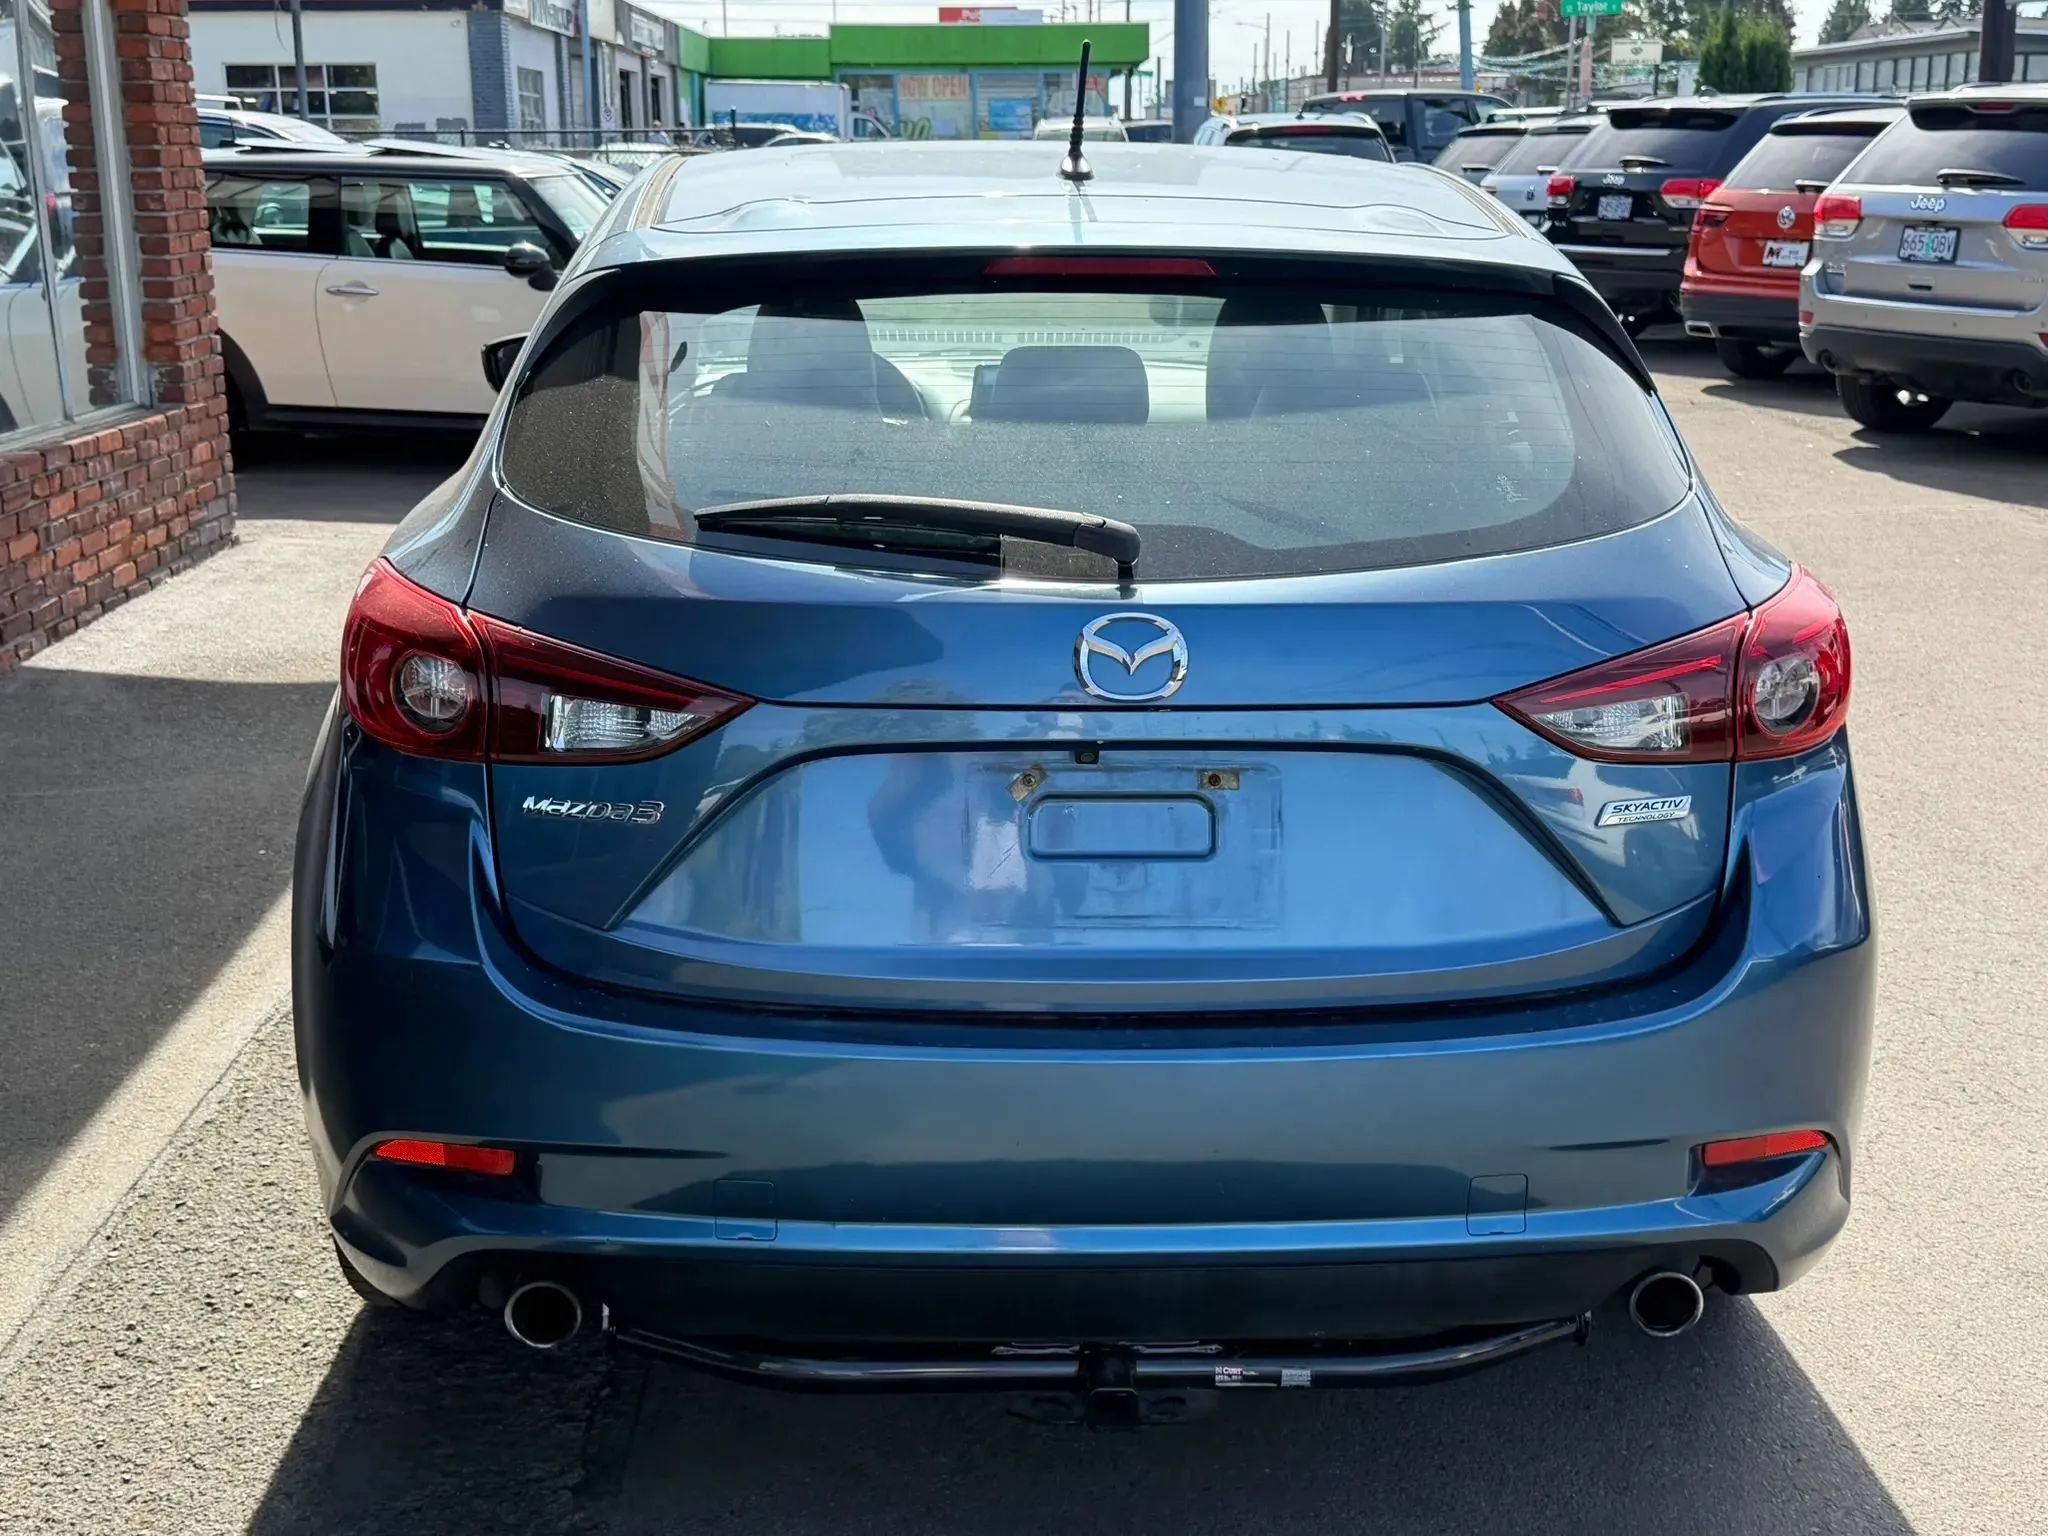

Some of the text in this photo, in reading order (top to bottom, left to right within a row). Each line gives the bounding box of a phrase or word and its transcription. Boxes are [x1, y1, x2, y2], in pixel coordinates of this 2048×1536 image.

[931, 75, 967, 98] OPEN
[1910, 194, 1946, 213] Jeep
[1611, 798, 1684, 814] SKYACTIV
[1618, 811, 1676, 823] TECHNOLOGY
